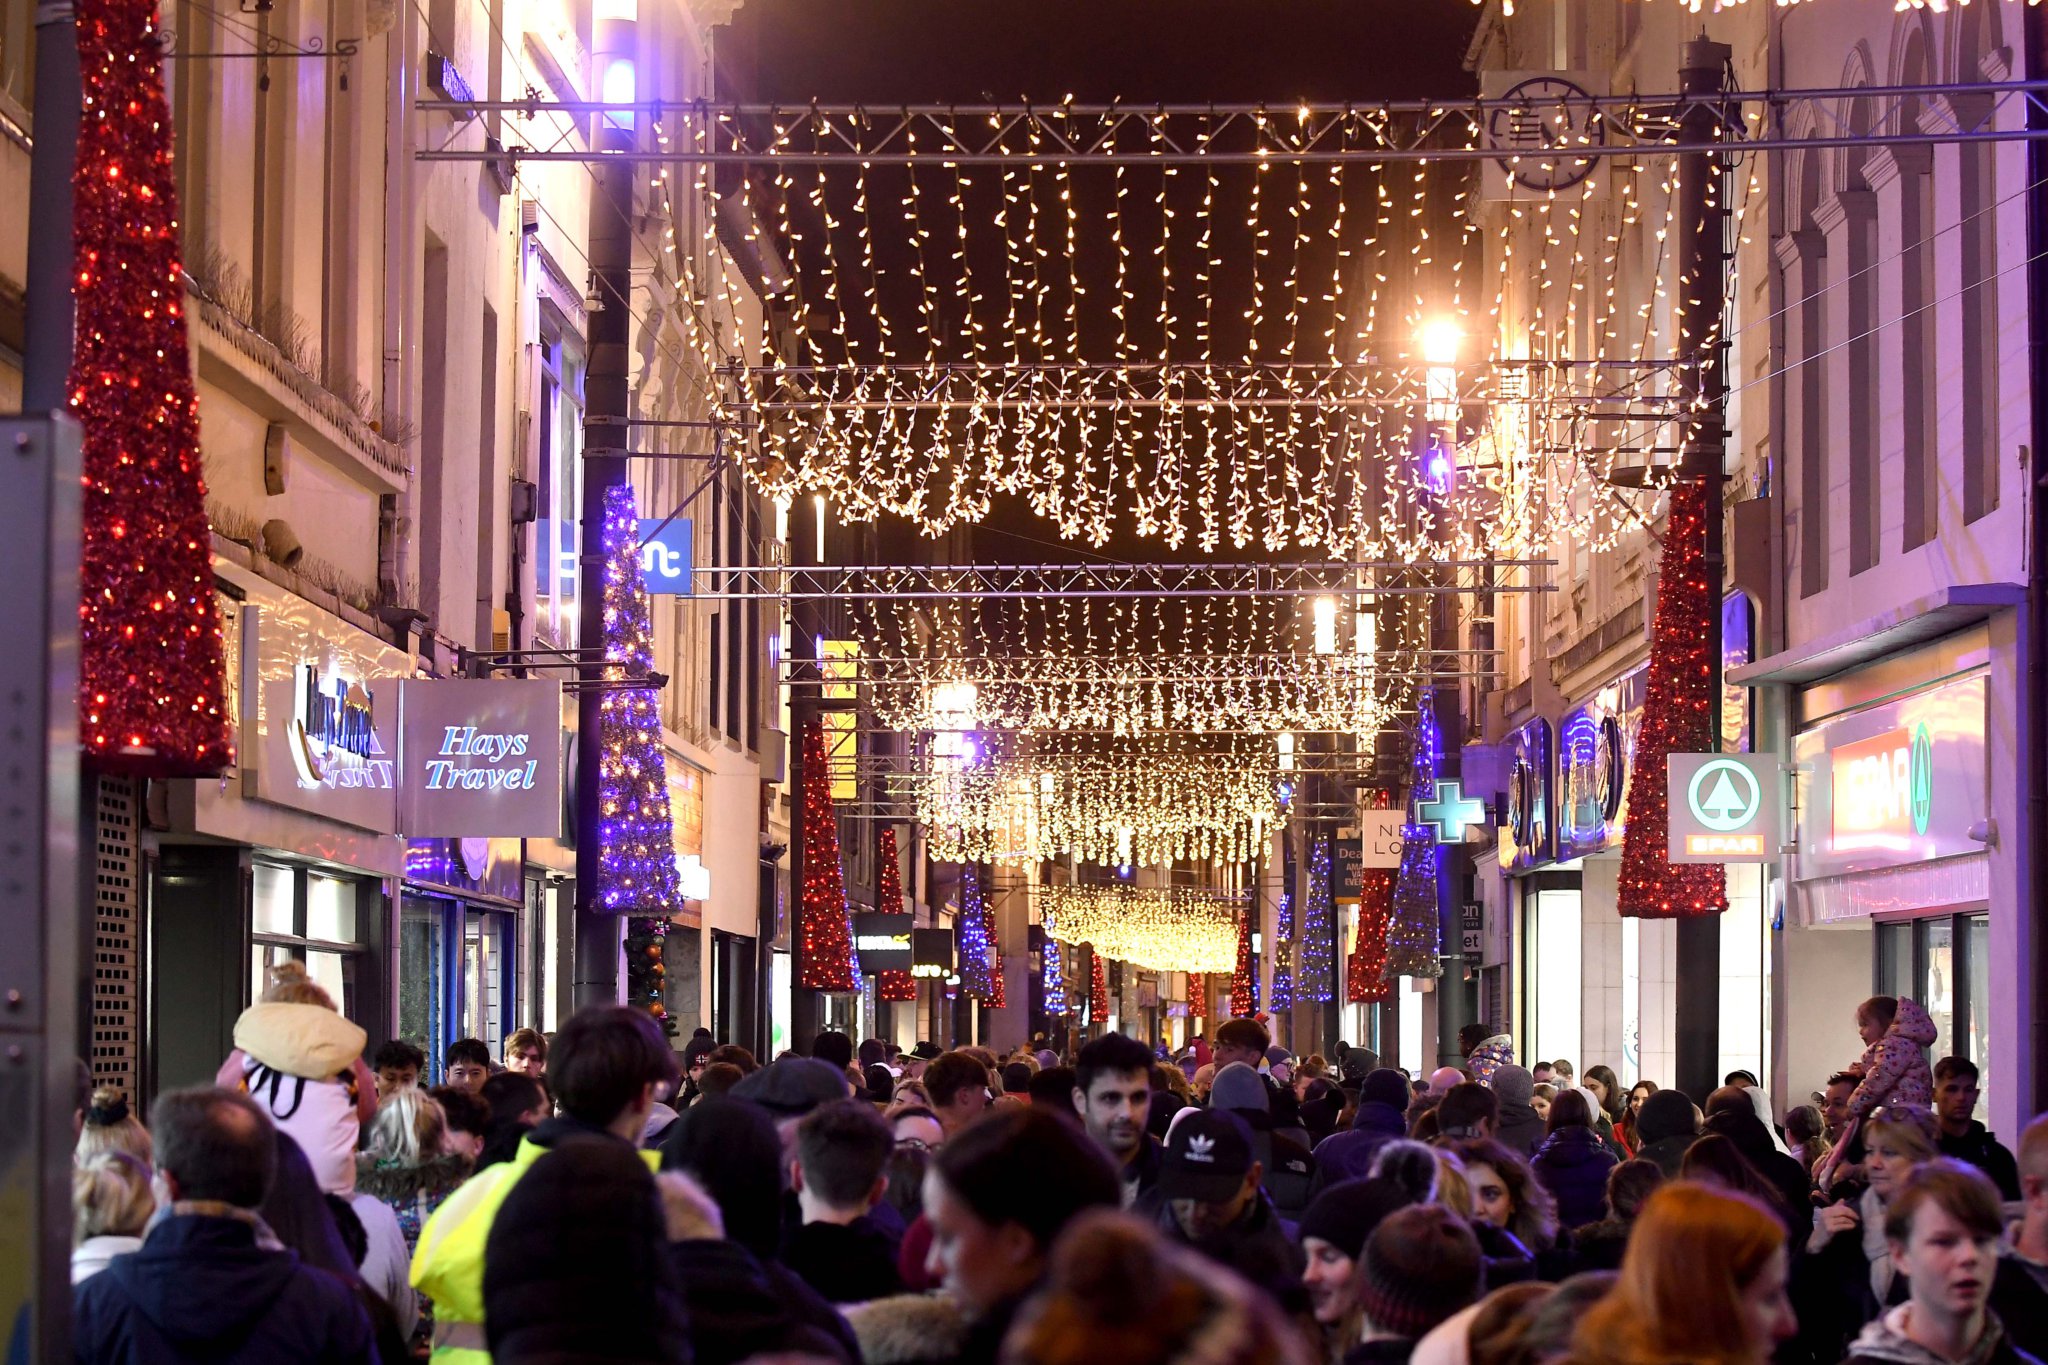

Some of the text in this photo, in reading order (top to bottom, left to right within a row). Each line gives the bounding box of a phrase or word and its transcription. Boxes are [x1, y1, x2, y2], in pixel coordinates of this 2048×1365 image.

[439, 726, 529, 762] Hays
[425, 760, 538, 790] Travel
[1379, 824, 1405, 837] NE
[1374, 841, 1402, 854] LO
[1691, 837, 1758, 853] SPAR
[1339, 848, 1363, 859] Dea
[1346, 863, 1363, 871] AMA
[1463, 933, 1479, 948] et
